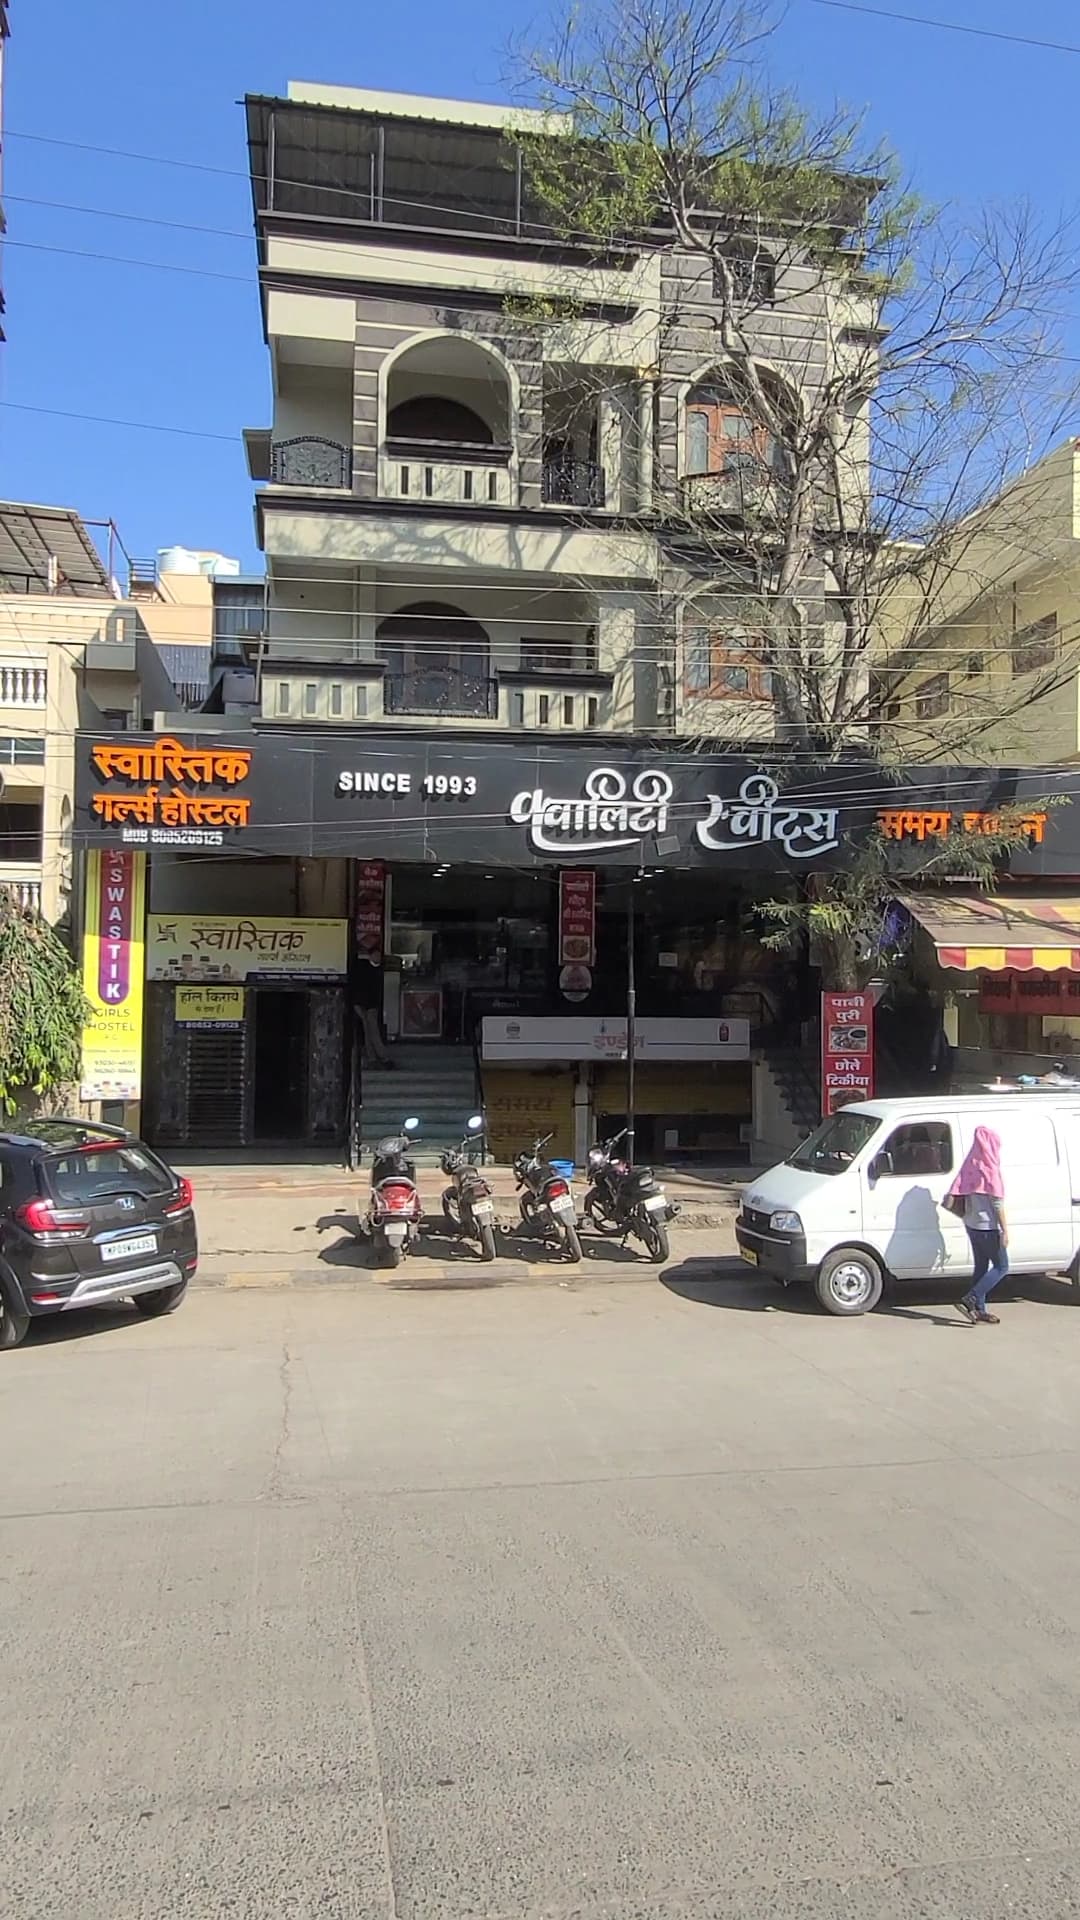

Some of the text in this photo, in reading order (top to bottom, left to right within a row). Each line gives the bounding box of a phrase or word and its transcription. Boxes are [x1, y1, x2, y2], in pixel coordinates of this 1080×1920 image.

[93, 737, 251, 784] स्वास्तिक
[338, 771, 477, 796] SINCE 1993
[93, 786, 251, 827] गर्ल्स होस्टल
[510, 768, 674, 852] क्वालिटी
[877, 810, 951, 841] समय
[107, 868, 125, 999] SWASTIK
[190, 920, 307, 952] स्वास्तिक
[96, 1008, 131, 1018] GIRLS
[831, 996, 865, 1007] पानी
[836, 1009, 861, 1022] पुरी
[88, 1022, 136, 1032] HOSTEL
[834, 1058, 861, 1071] छोले
